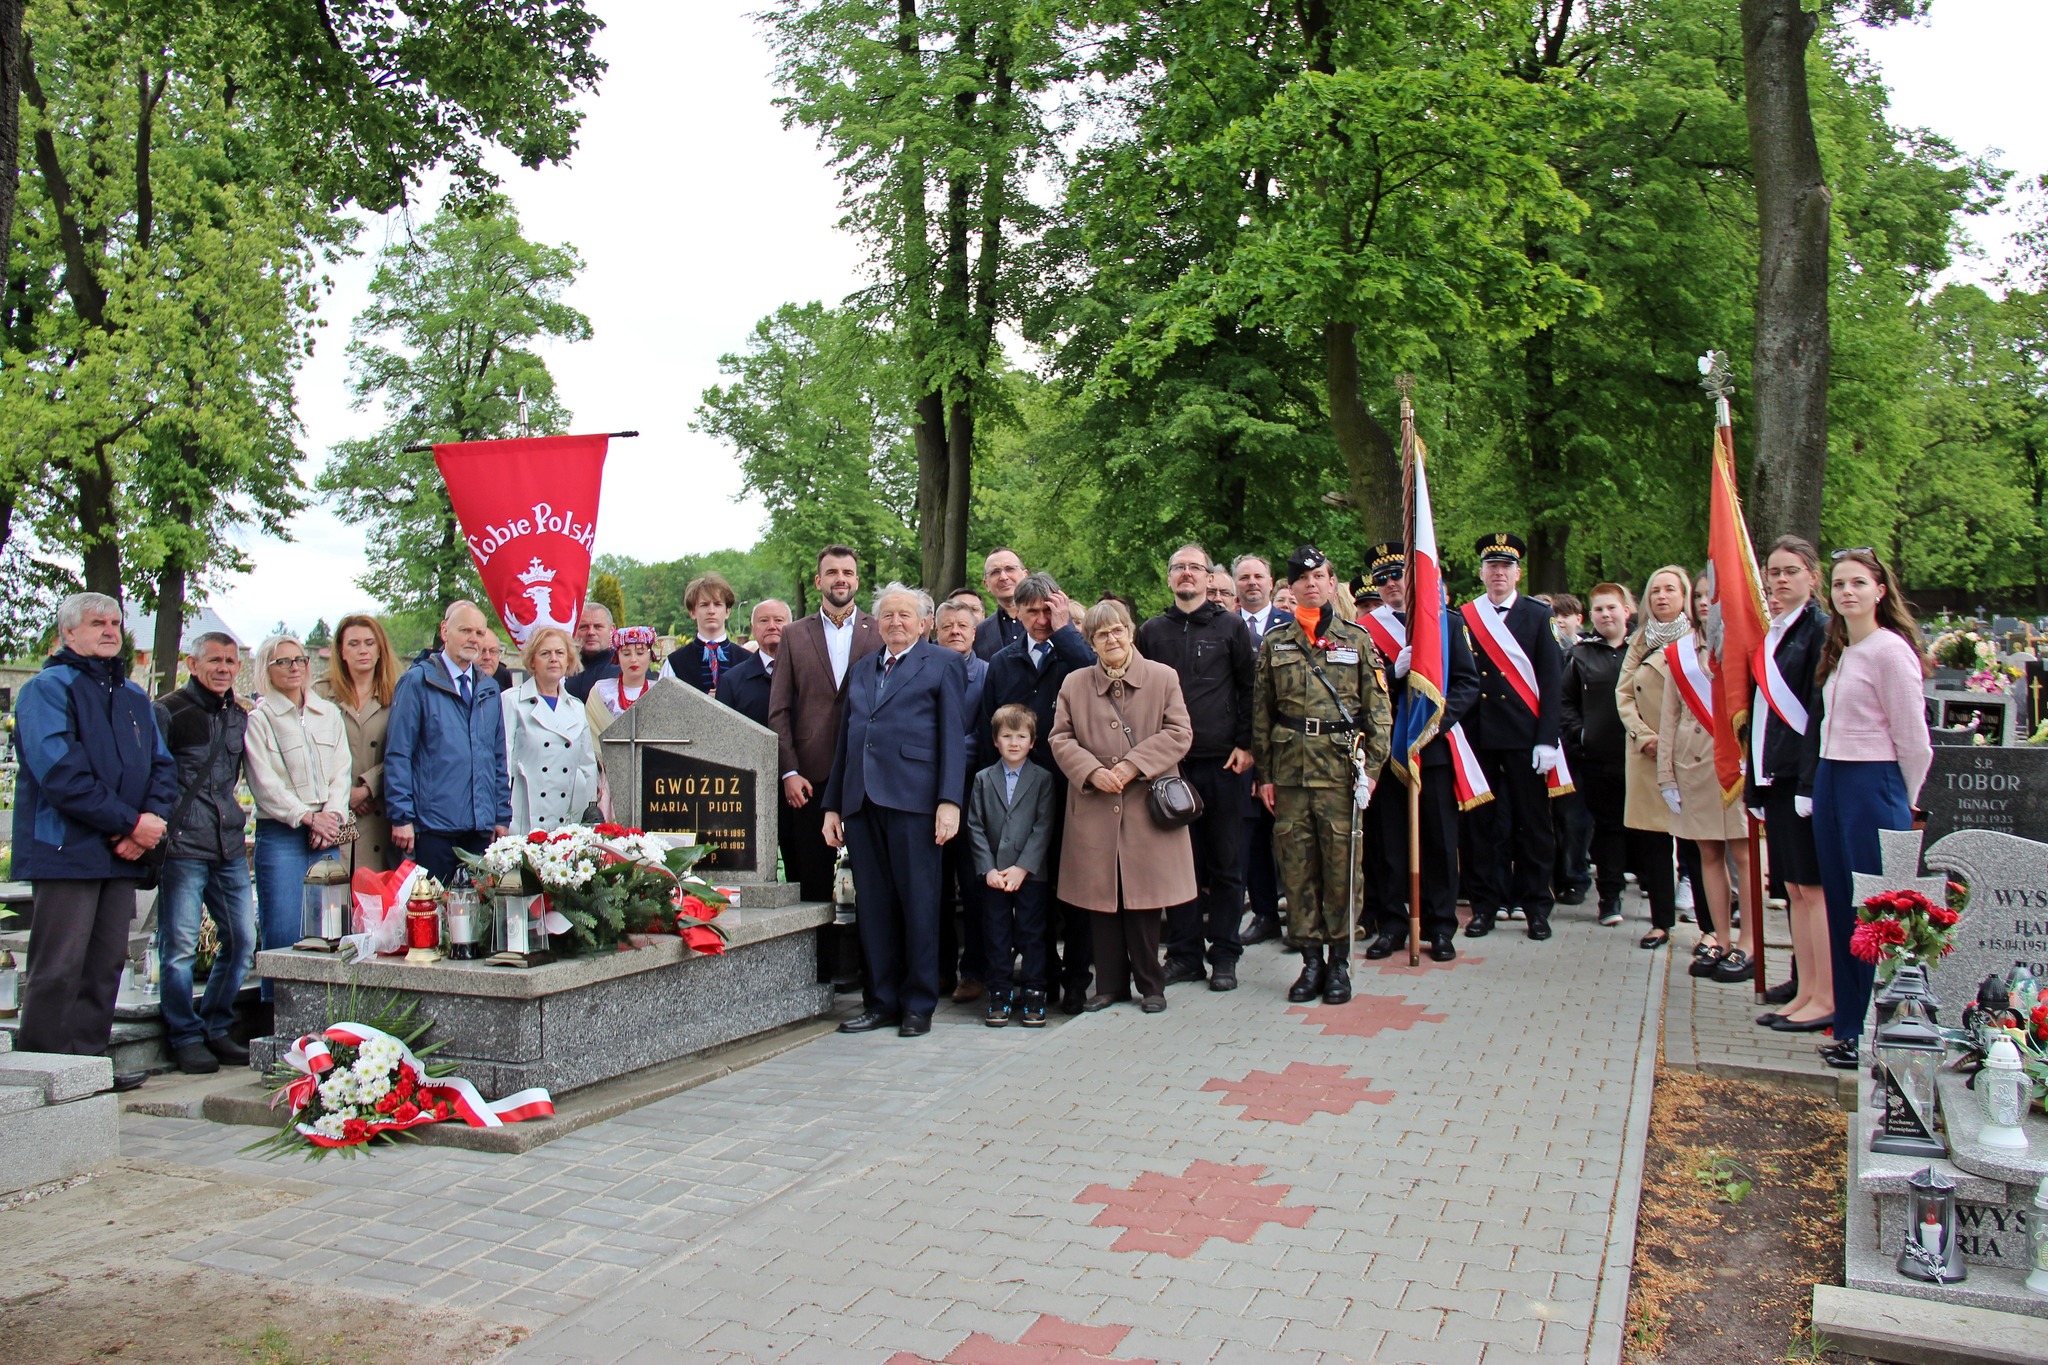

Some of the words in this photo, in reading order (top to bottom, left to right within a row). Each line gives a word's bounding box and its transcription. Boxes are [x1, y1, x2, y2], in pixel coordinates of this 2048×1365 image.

[467, 518, 531, 566] Tobie
[655, 774, 740, 795] GWÓŹDŹ
[1945, 773, 2021, 791] TOBOR
[650, 801, 689, 813] MARIA
[708, 801, 743, 813] PIOTR
[1958, 798, 2010, 811] IGNACY
